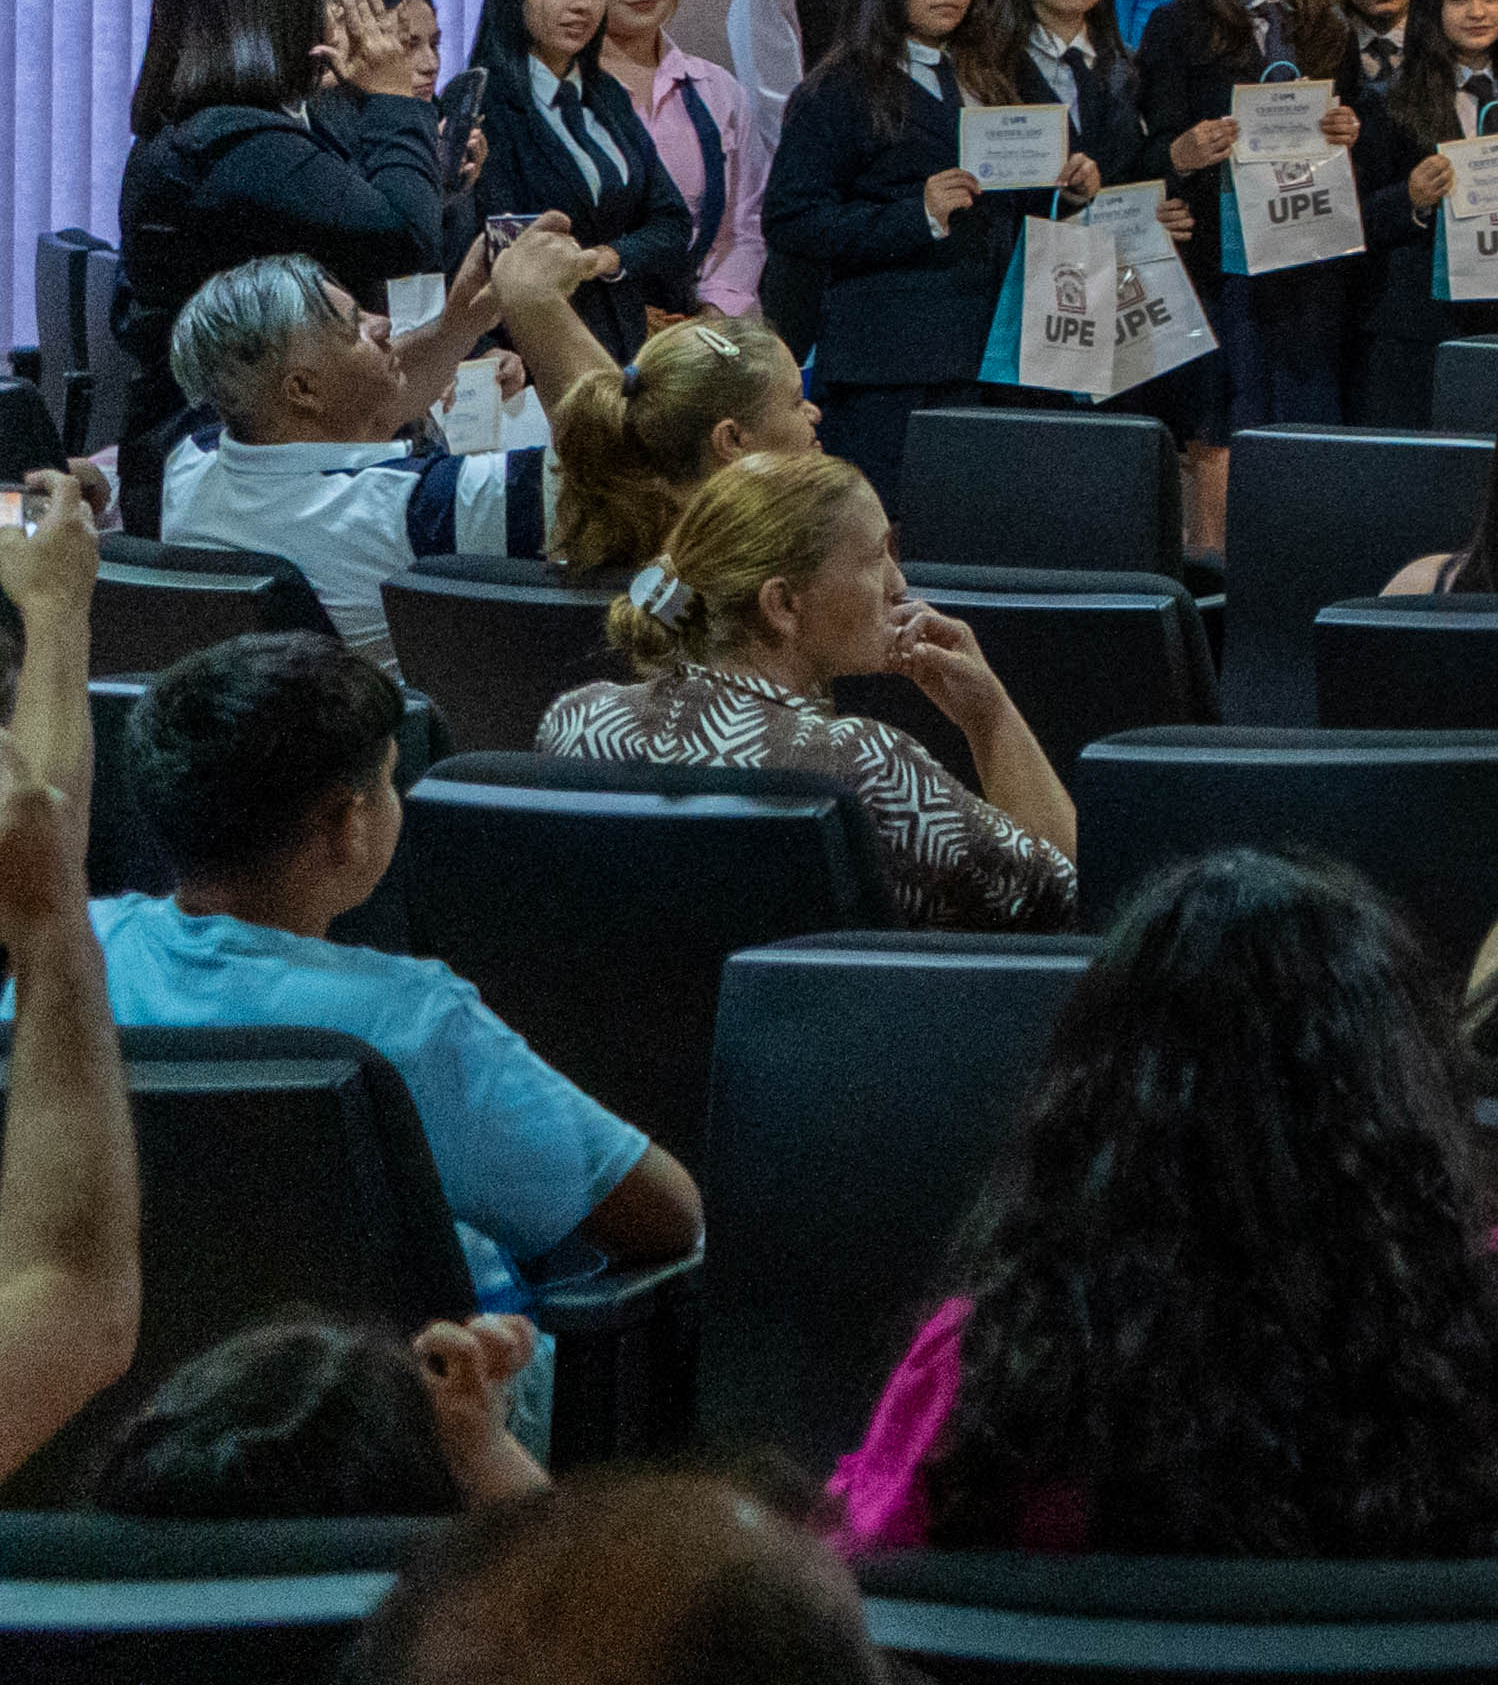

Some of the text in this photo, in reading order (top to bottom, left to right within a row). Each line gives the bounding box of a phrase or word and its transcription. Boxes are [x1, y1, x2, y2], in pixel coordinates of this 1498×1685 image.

[1010, 116, 1027, 124] UPE
[1268, 189, 1332, 224] UPE
[1045, 315, 1096, 347] UPE
